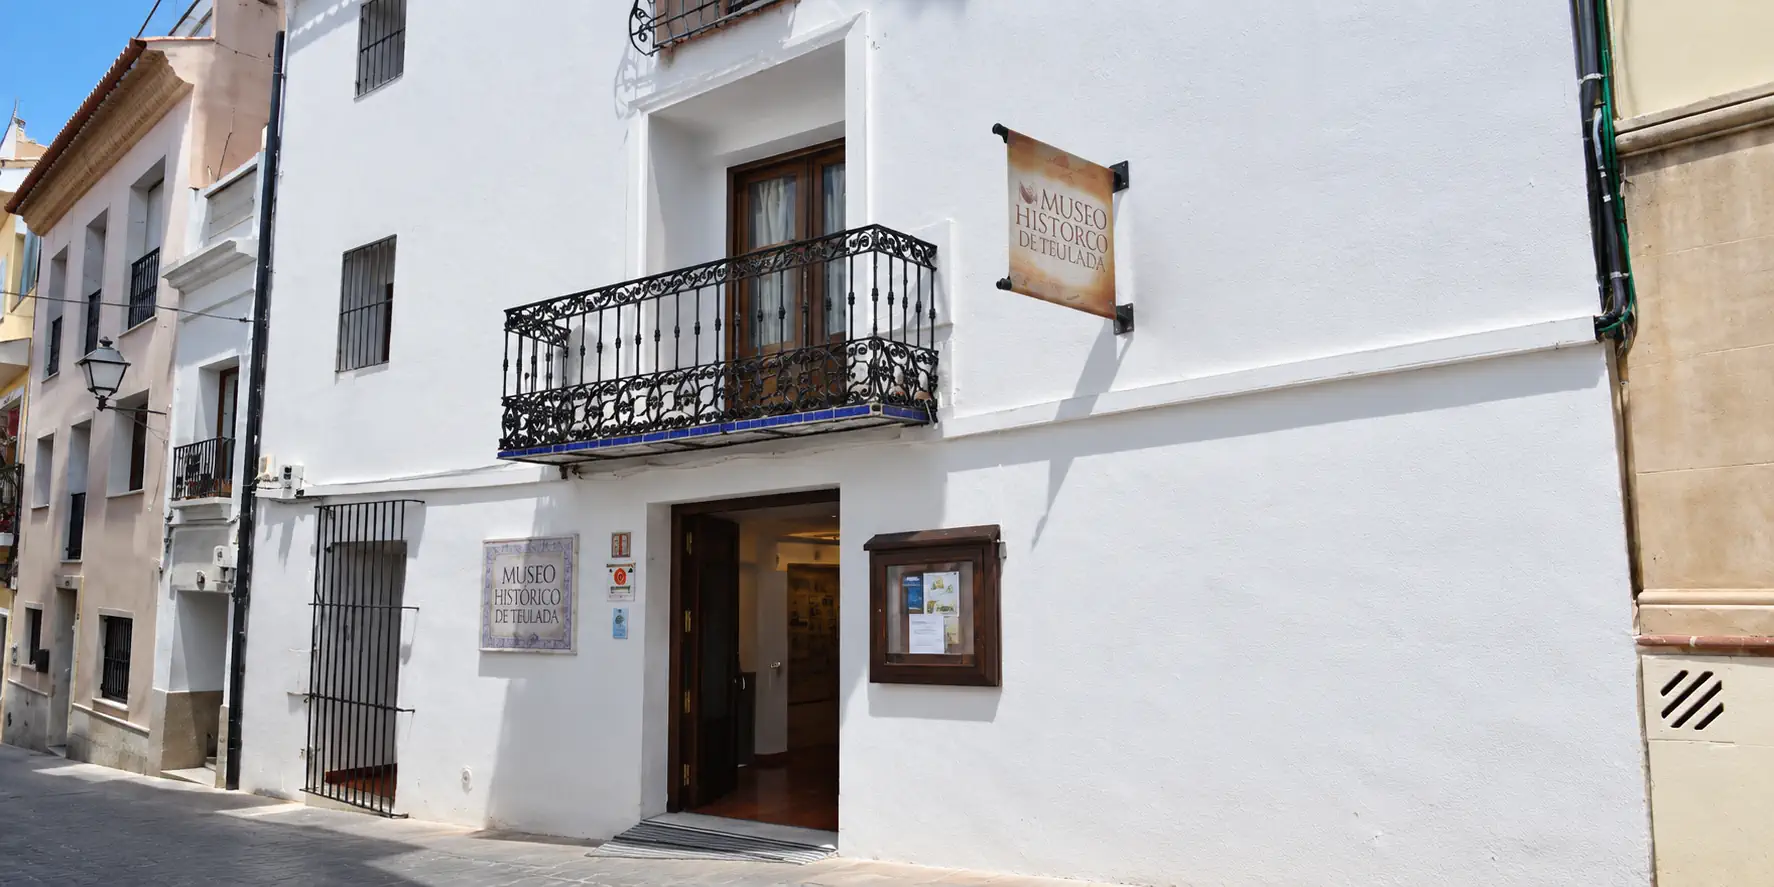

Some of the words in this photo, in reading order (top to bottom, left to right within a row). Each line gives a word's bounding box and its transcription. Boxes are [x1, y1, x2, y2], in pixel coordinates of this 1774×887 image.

[1041, 188, 1107, 230] MUSEO
[1016, 204, 1108, 254] HISTORCO
[1019, 229, 1037, 251] DE
[1039, 236, 1106, 273] TEULADA
[502, 564, 556, 584] MUSEO
[494, 584, 561, 606] HISTÓRICO
[495, 609, 509, 624] DE
[510, 609, 559, 624] TEULADA
